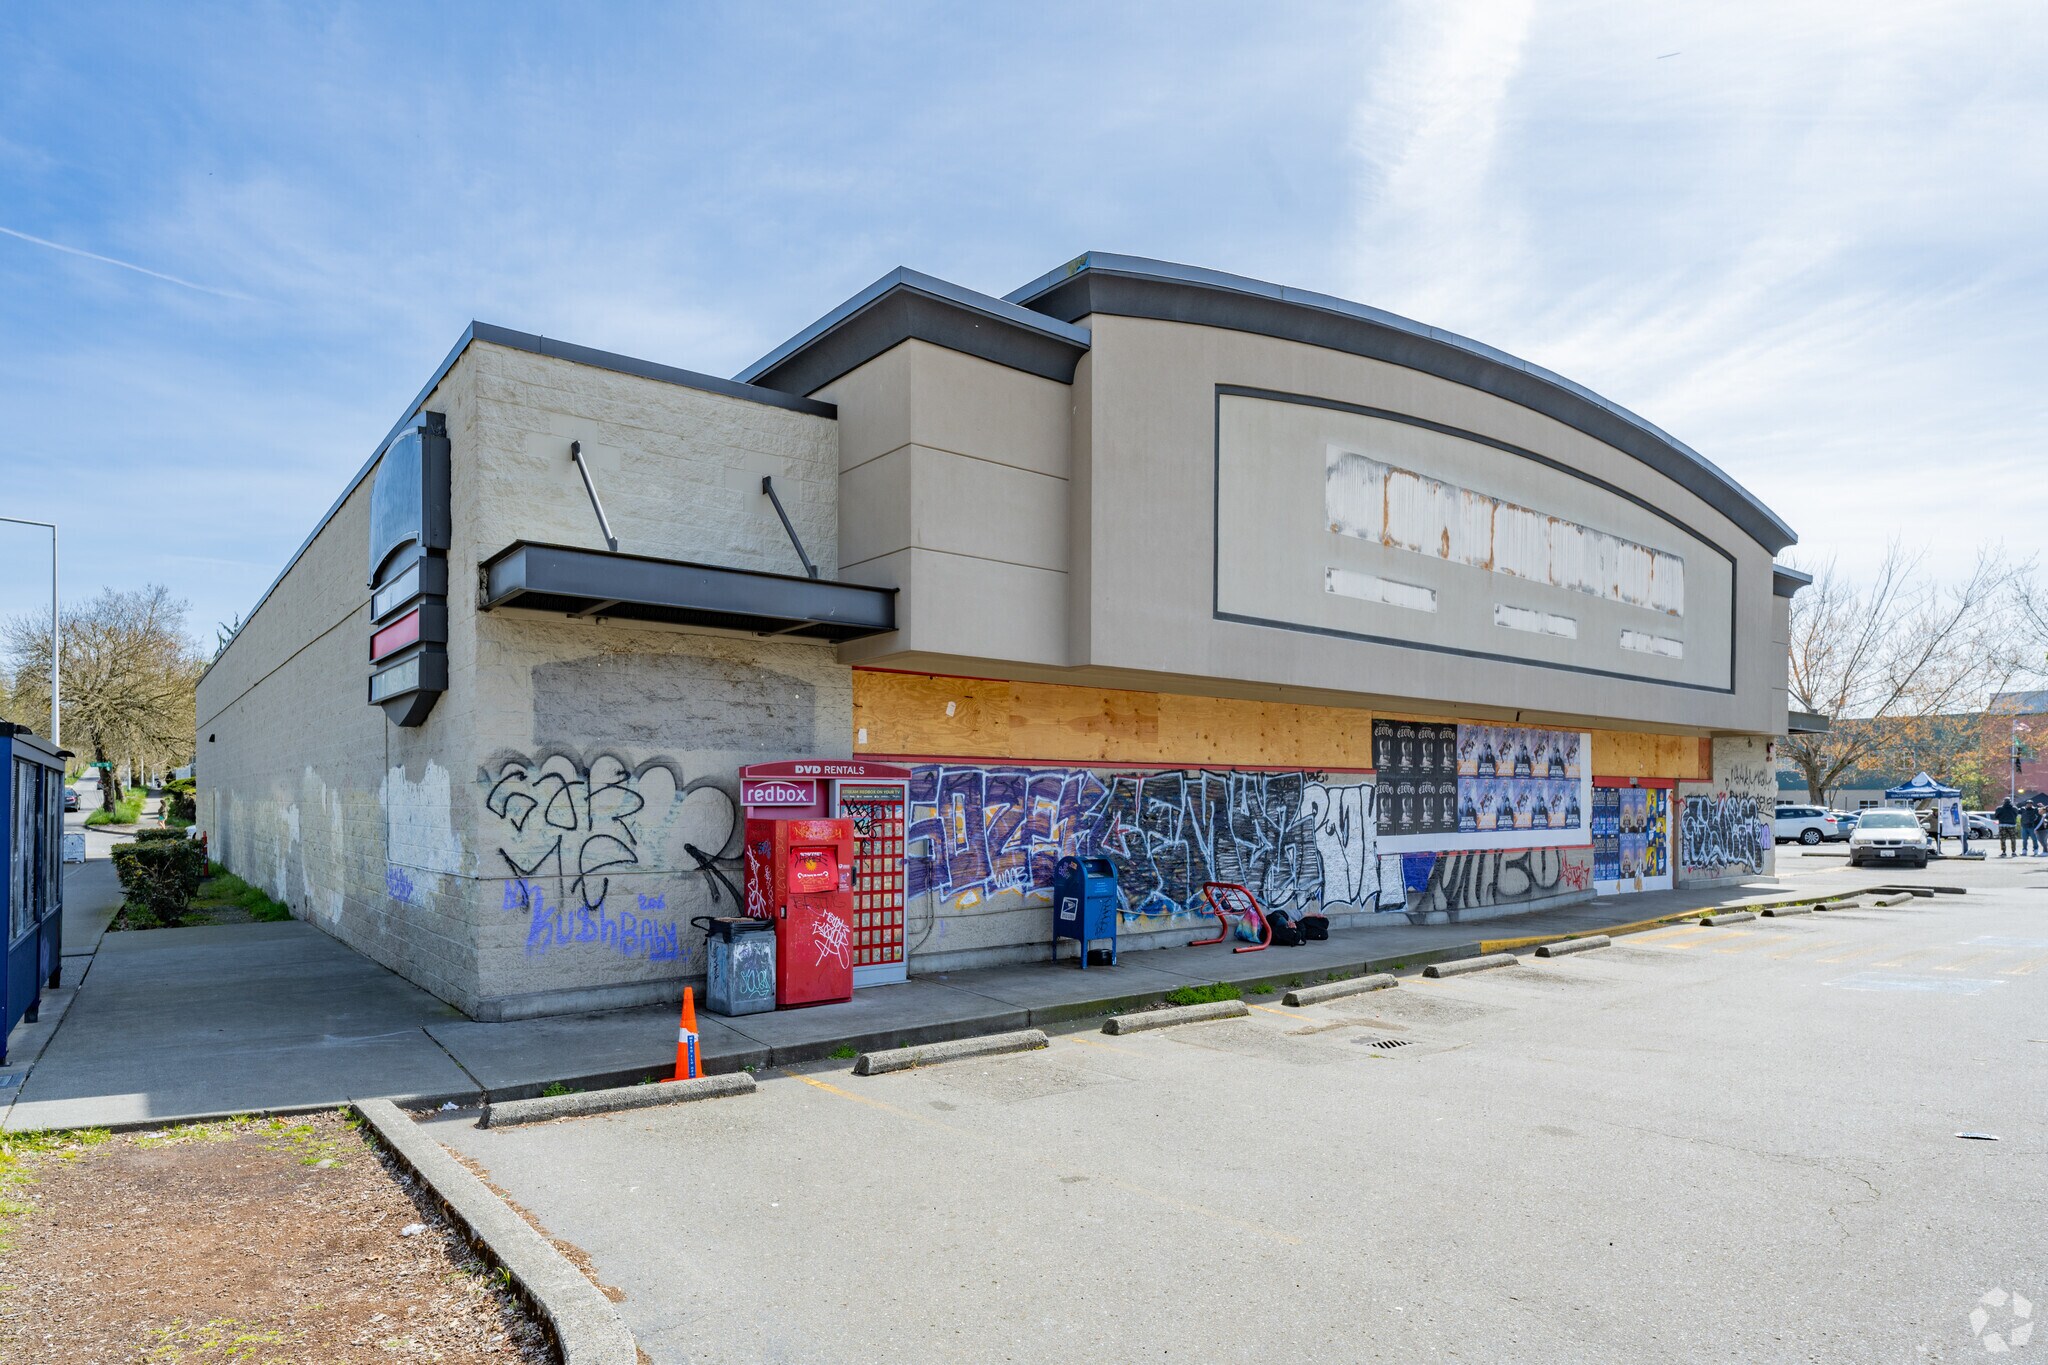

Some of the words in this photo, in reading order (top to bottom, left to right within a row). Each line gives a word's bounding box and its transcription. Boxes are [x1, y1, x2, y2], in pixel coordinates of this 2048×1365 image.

[795, 765, 822, 774] DVD
[824, 765, 865, 775] RENTALS
[747, 785, 808, 802] redbox
